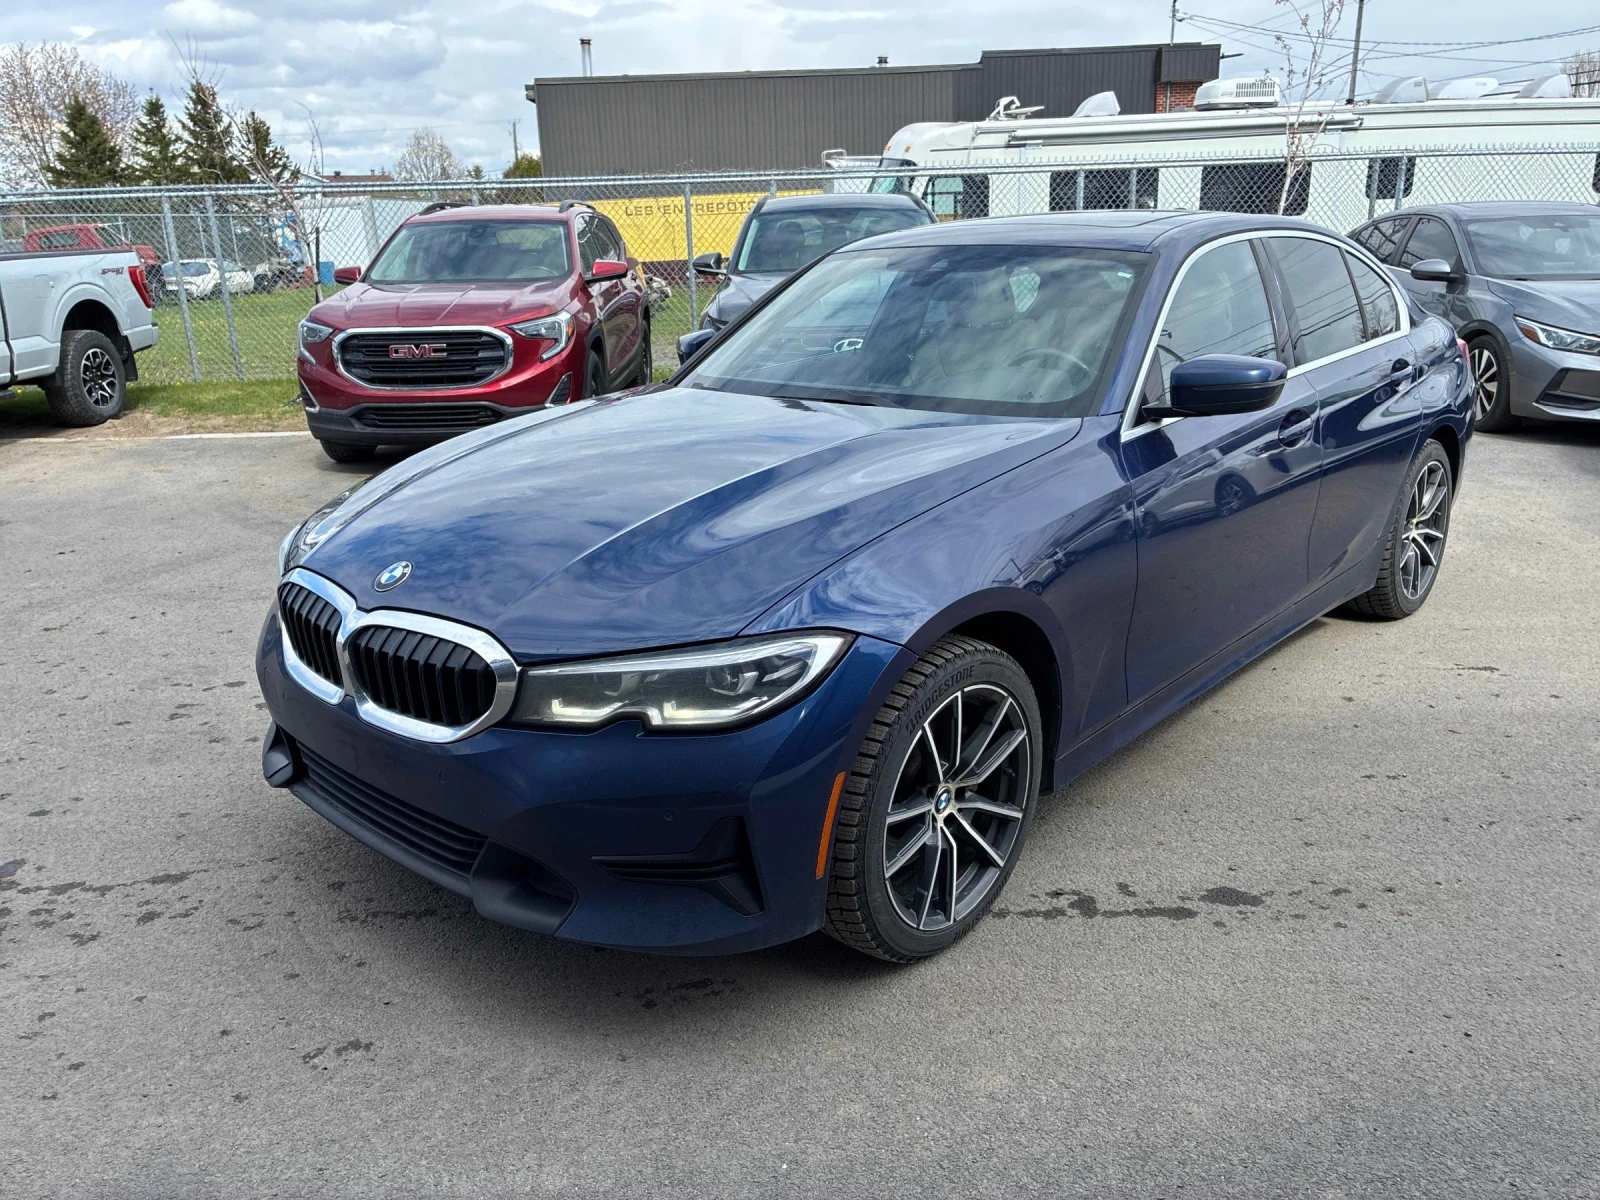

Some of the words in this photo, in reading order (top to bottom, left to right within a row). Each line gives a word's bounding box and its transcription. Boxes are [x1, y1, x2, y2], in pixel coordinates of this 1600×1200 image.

[625, 206, 654, 217] LES
[663, 200, 756, 215] ENREPÔT
[388, 344, 447, 359] GMC
[906, 666, 975, 737] BRIDGESTONE
